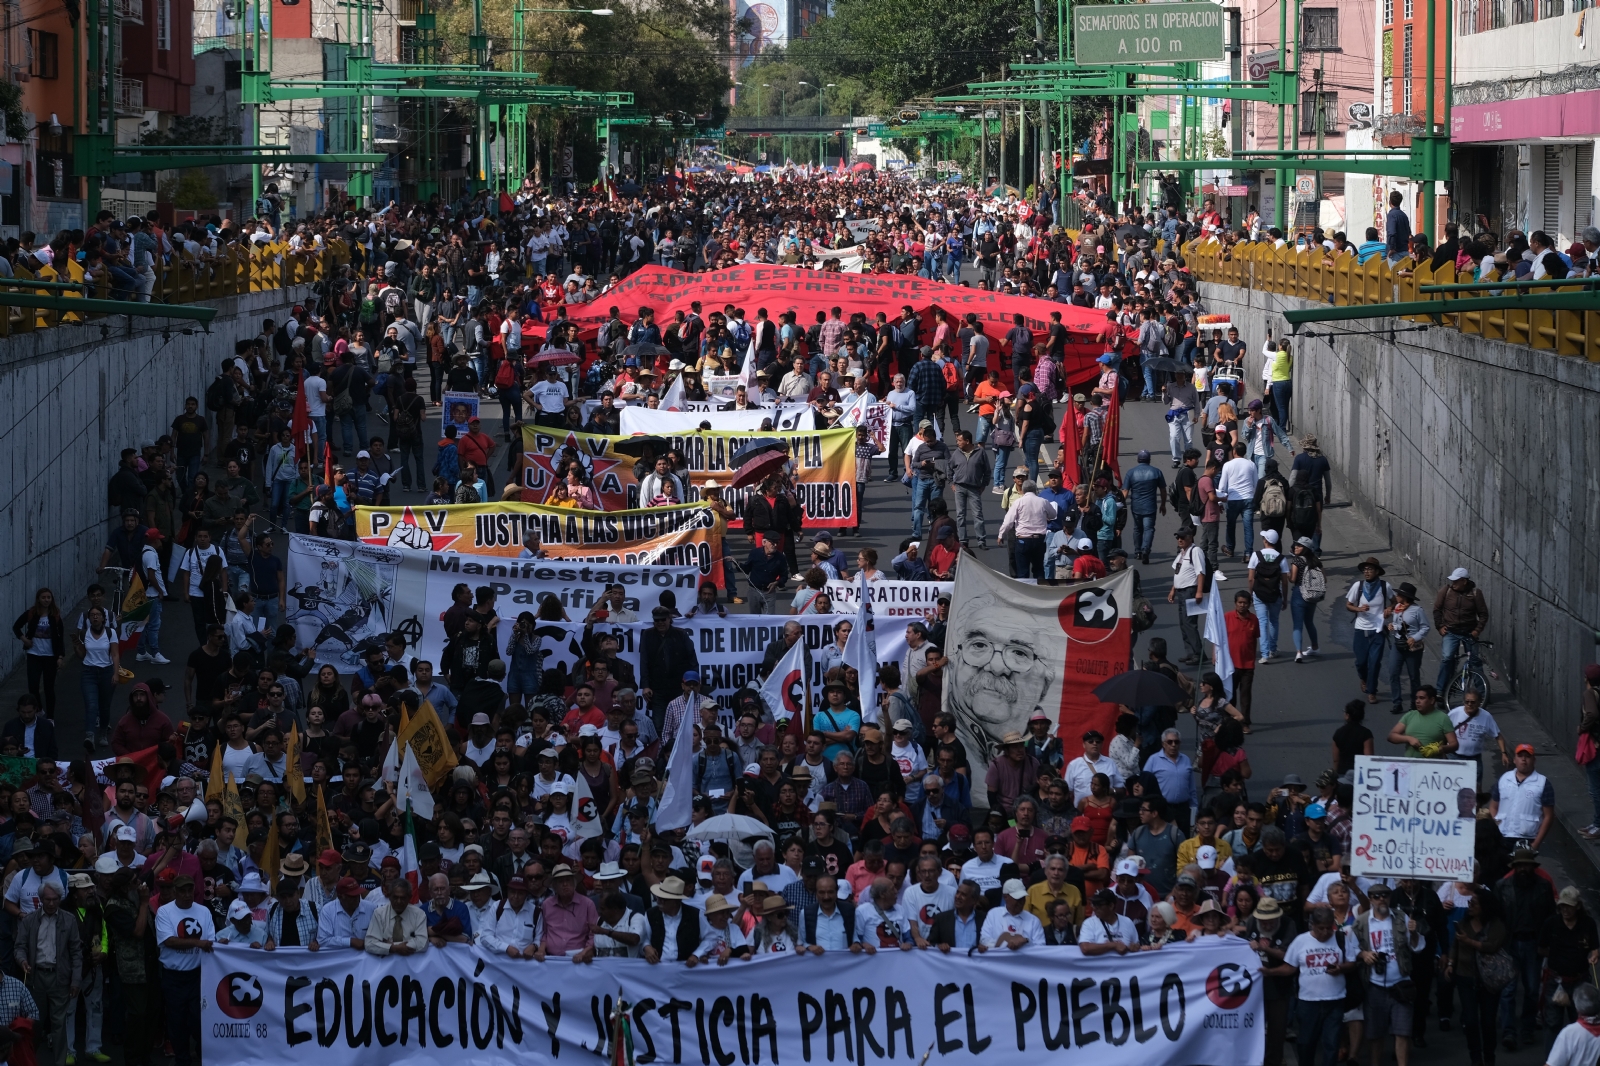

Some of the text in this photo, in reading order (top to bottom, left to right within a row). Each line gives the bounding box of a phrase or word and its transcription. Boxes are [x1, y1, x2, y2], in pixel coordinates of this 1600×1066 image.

[1079, 11, 1219, 31] SEMAFOROS EN OPERACION
[1118, 37, 1182, 54] A 100 m
[712, 269, 746, 283] DE
[536, 434, 609, 458] P V
[708, 437, 726, 471] LA
[804, 435, 823, 468] LA
[526, 468, 623, 494] U A
[796, 482, 852, 519] PUEBLO
[371, 510, 448, 535] P V
[475, 513, 563, 547] JUSTICIA
[566, 513, 580, 545] A
[583, 513, 619, 544] LAS
[430, 555, 696, 588] Manifestación
[489, 582, 640, 612] Pacífia
[612, 628, 634, 653] 51
[700, 628, 726, 653] DE
[1113, 661, 1125, 677] 68
[1417, 771, 1464, 792] AÑOS
[1407, 790, 1422, 799] DE
[1374, 815, 1463, 836] IMPUNE
[1355, 834, 1445, 861] 2 DE Octubre
[1382, 856, 1404, 870] NO
[1408, 856, 1422, 870] SE
[283, 958, 523, 1050] EDUCACIÓN
[541, 991, 562, 1059] Y
[797, 986, 915, 1066] PARA
[934, 982, 993, 1056] EL
[1011, 973, 1186, 1051] PUEBLO
[212, 1020, 268, 1039] COMITÉ 68
